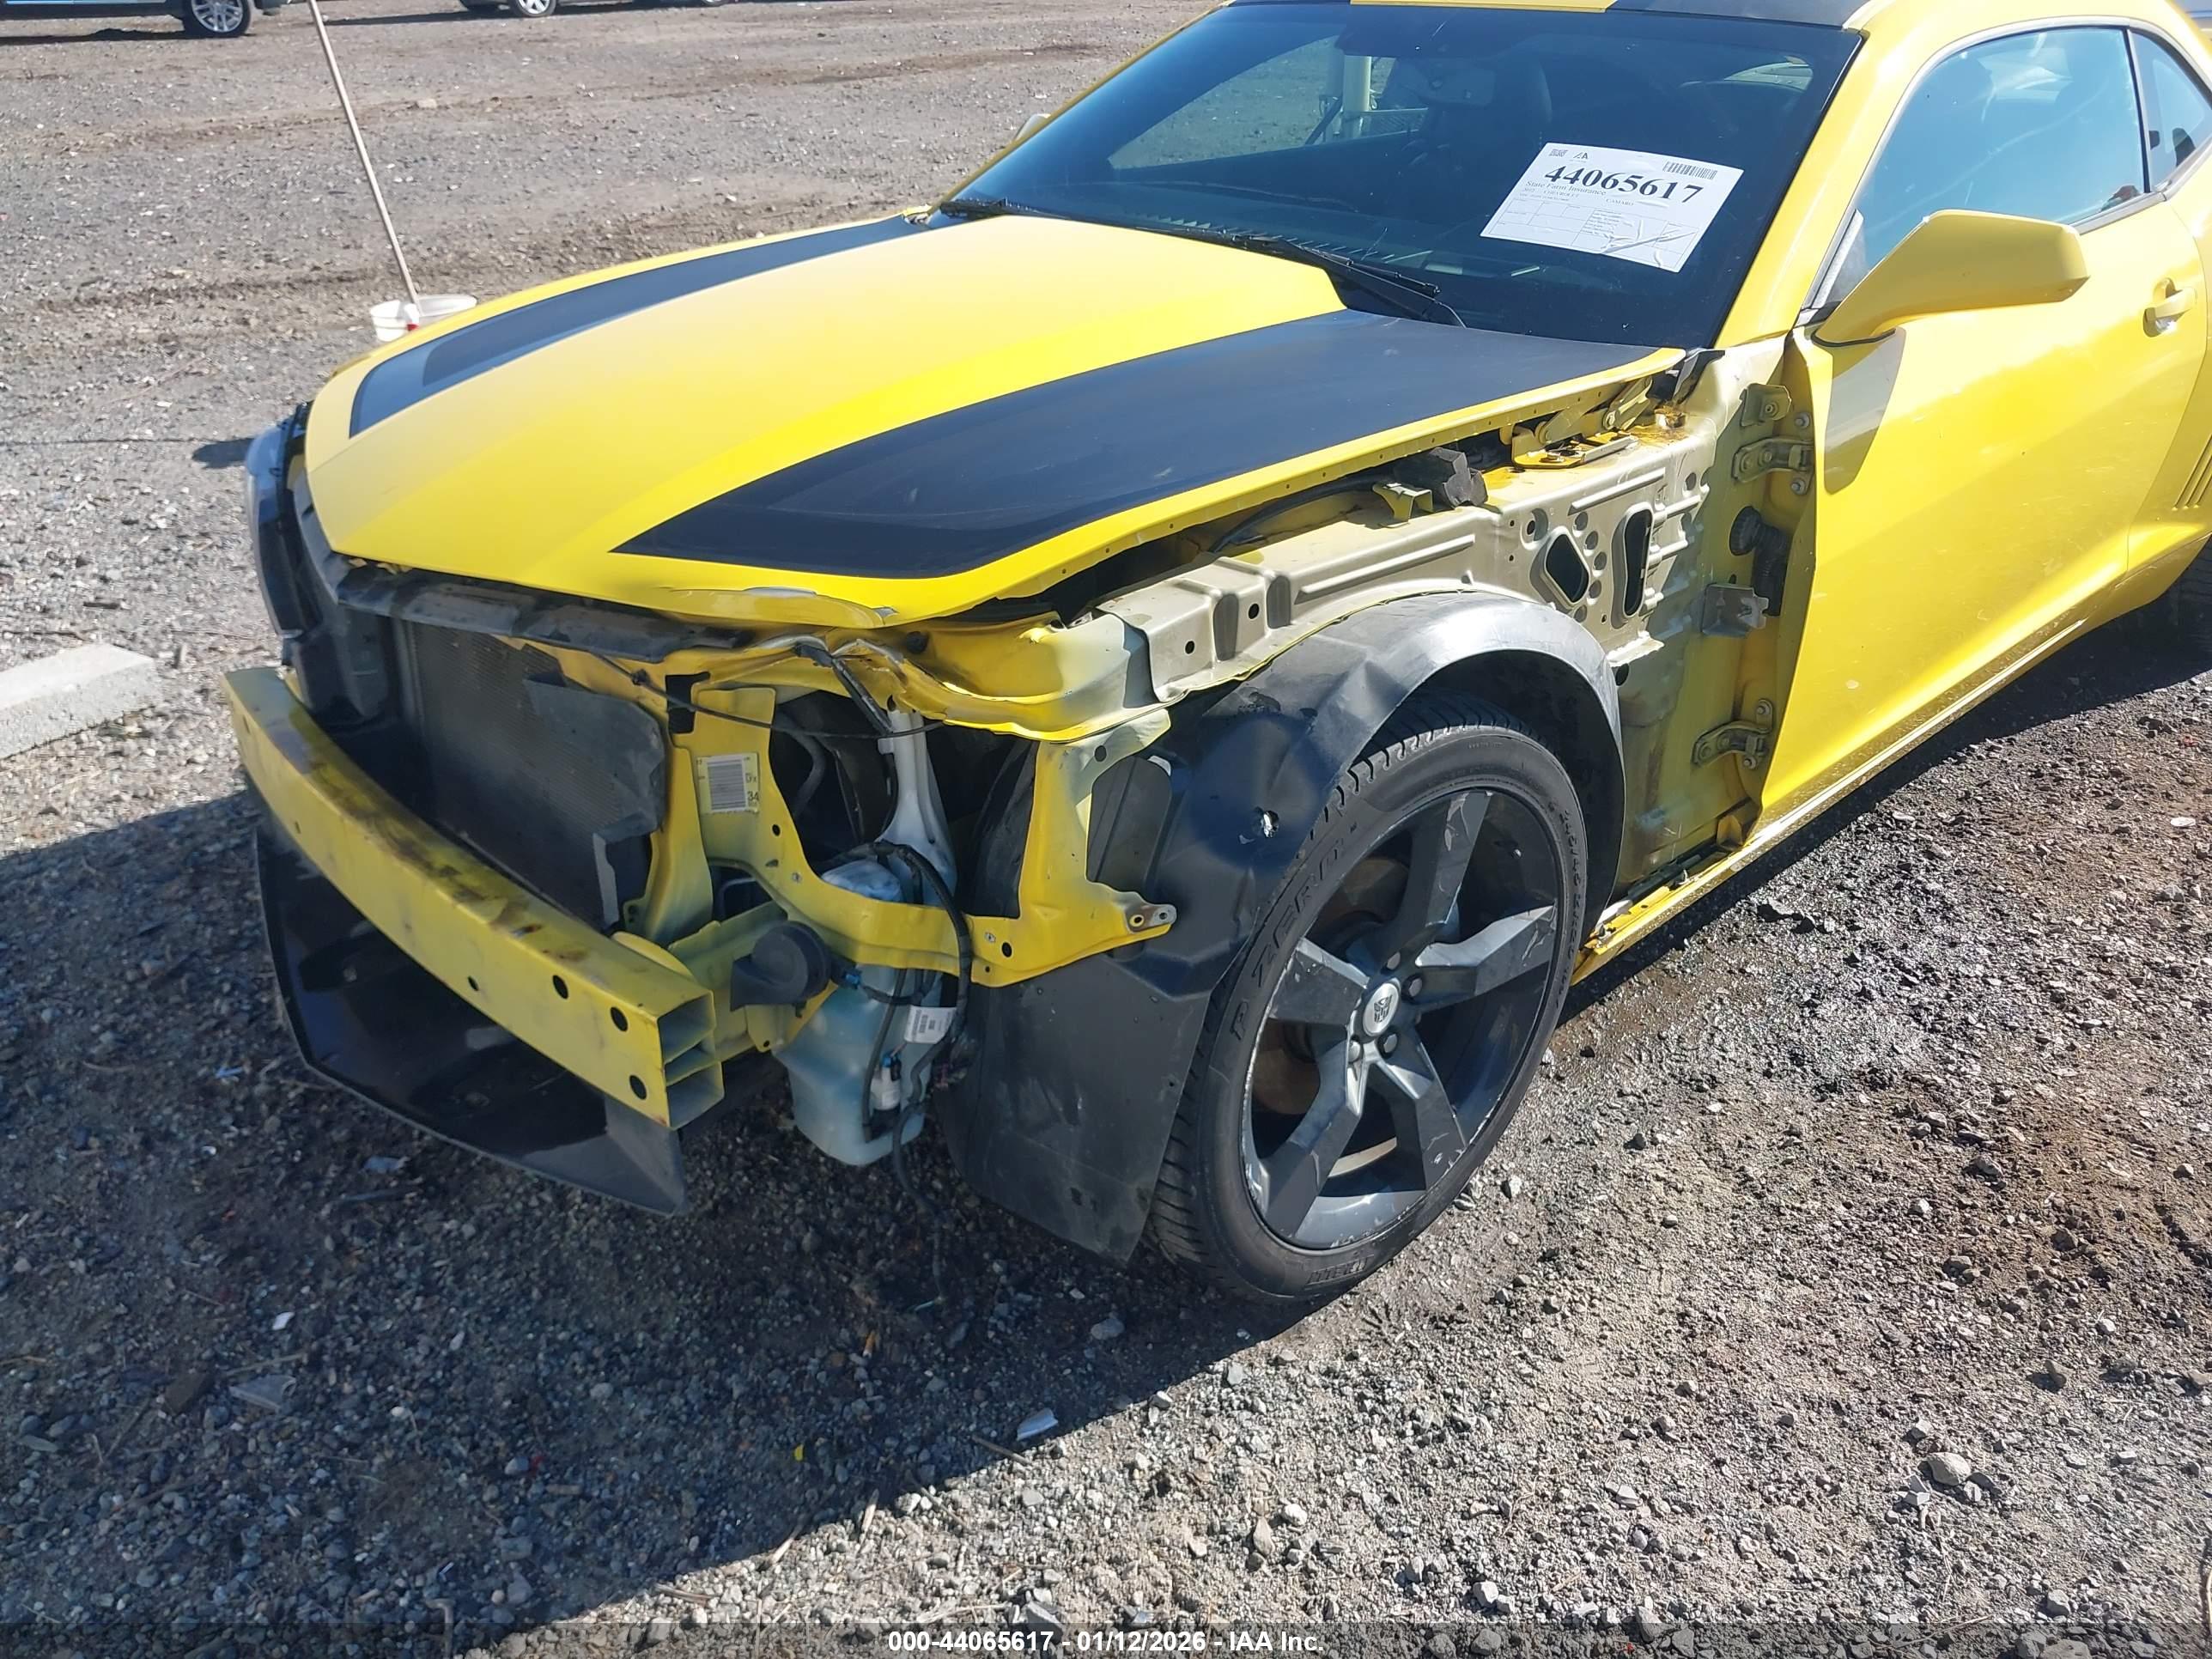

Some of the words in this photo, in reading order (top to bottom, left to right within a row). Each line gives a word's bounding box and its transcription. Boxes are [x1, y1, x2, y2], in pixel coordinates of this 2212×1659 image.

[1526, 180, 1546, 189] State
[1568, 185, 1607, 197] Insurance
[1545, 165, 1704, 204] 44065617
